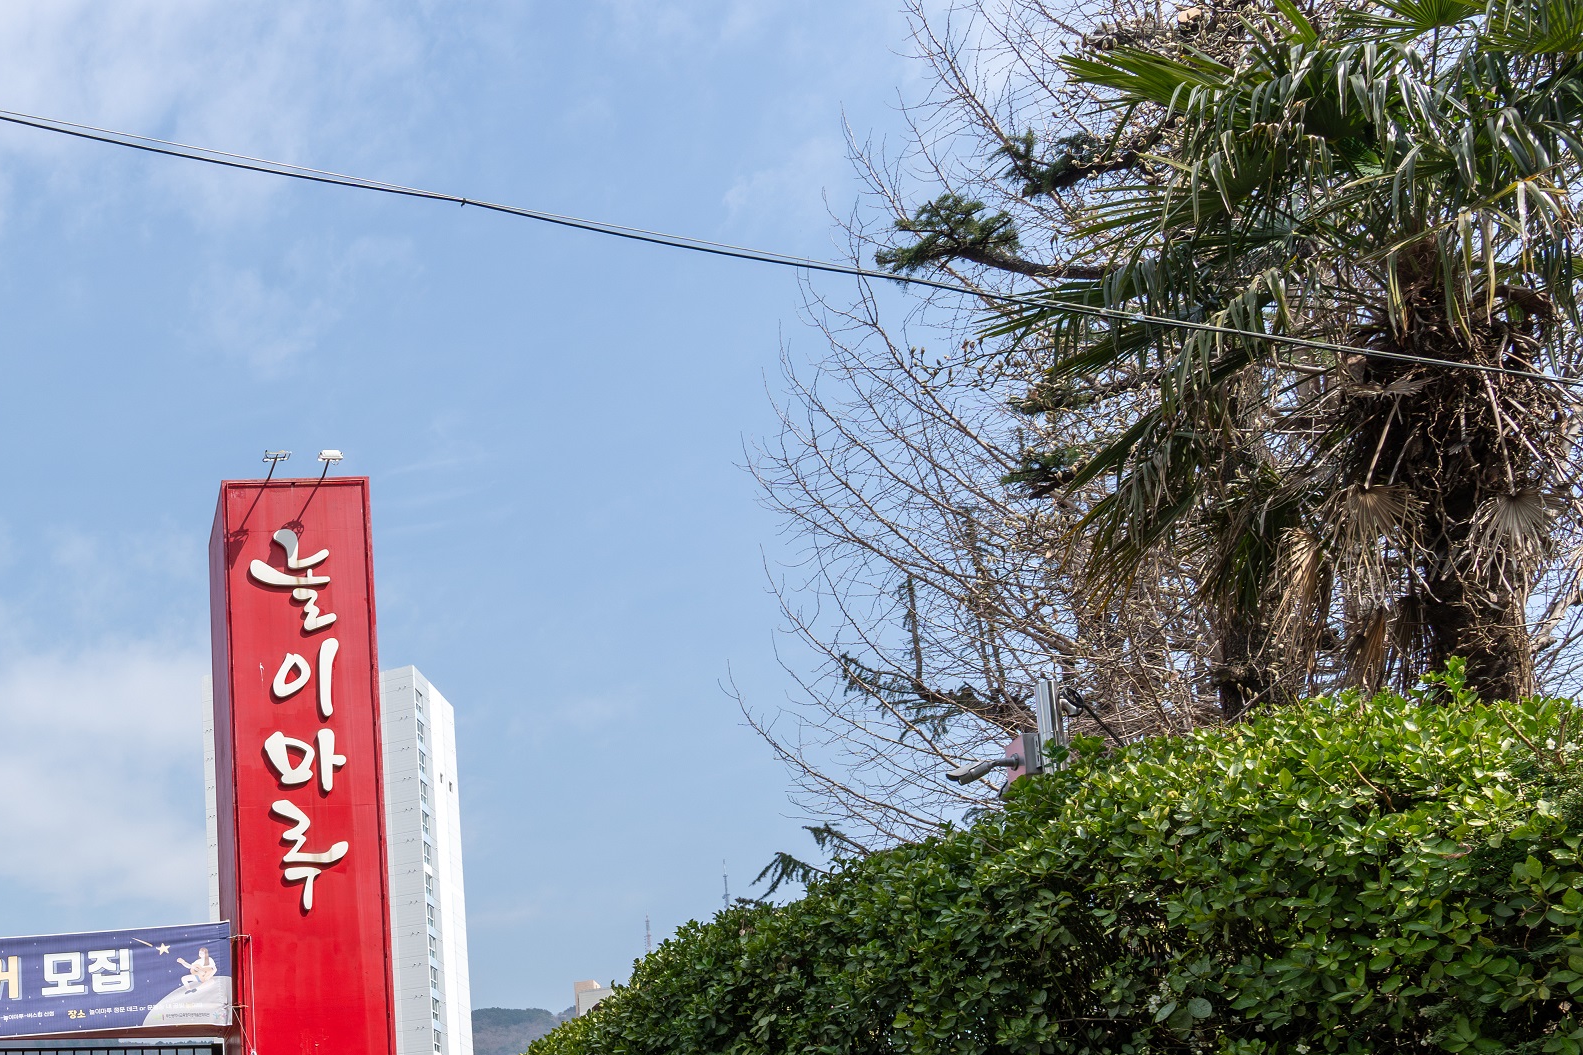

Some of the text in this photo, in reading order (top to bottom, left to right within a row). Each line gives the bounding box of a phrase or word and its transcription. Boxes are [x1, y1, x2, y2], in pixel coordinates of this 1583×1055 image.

[249, 528, 349, 910] 놀이마루
[41, 947, 135, 999] 모집
[67, 1009, 86, 1019] 장소
[89, 1006, 113, 1016] 놀이마루
